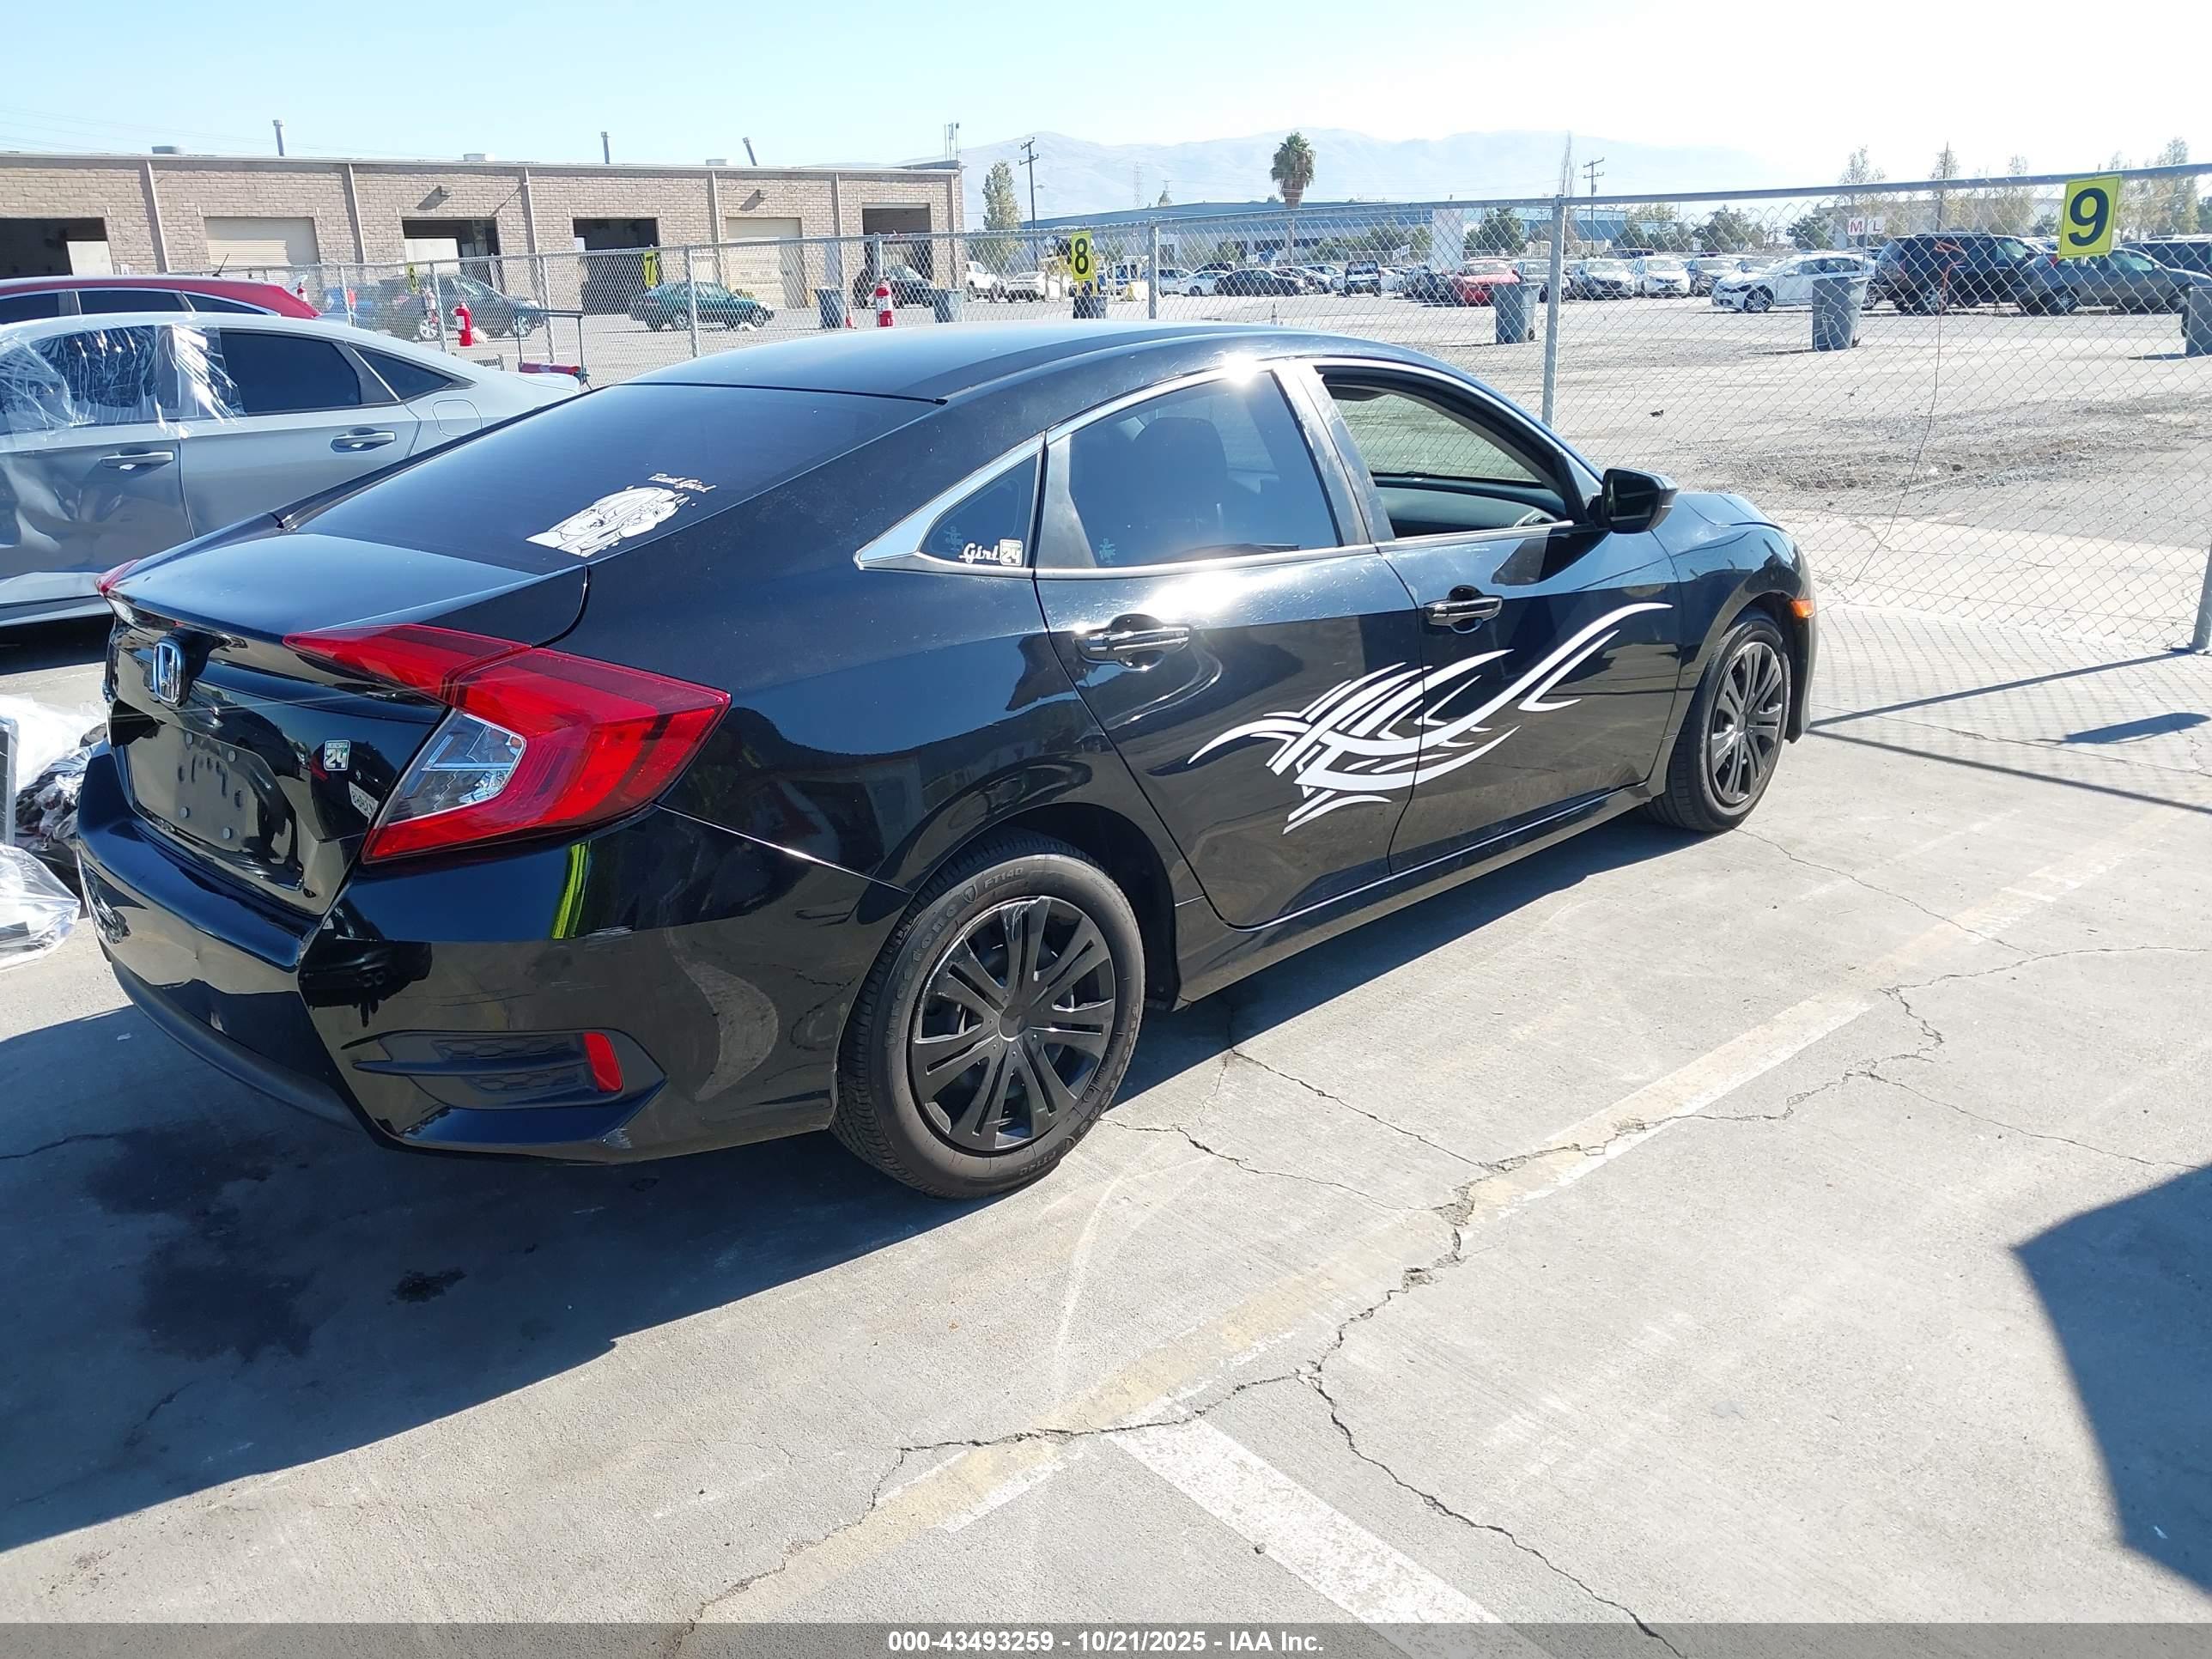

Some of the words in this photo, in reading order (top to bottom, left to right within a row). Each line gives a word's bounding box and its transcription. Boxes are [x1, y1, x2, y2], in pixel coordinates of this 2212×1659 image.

[1850, 221, 1863, 233] M
[1873, 221, 1881, 231] L
[2068, 187, 2110, 246] 9
[1074, 237, 1089, 275] 8
[410, 267, 416, 289] 6
[646, 255, 653, 282] 7
[958, 543, 1000, 564] Girl
[1001, 548, 1021, 564] 24
[326, 748, 348, 769] 24
